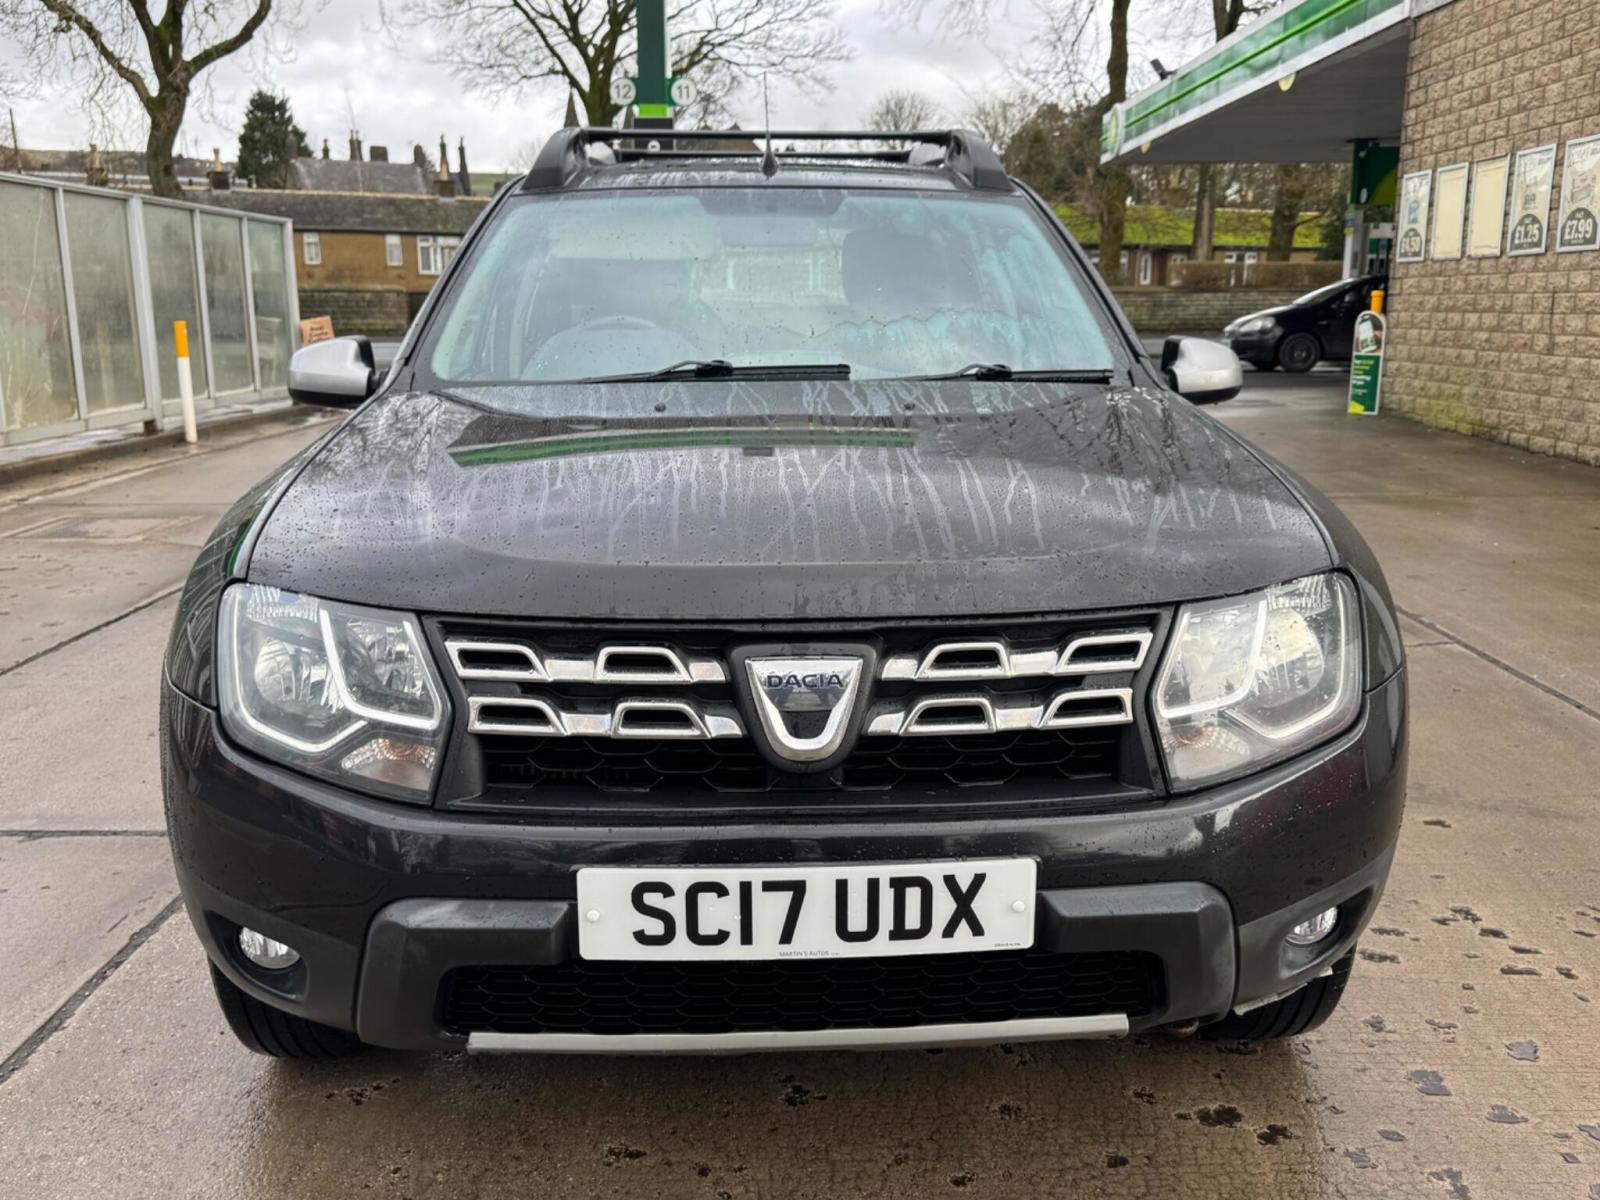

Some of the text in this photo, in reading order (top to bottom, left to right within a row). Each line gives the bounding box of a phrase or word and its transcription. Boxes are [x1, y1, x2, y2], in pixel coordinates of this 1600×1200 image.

[614, 84, 632, 100] 12
[676, 84, 691, 100] 11
[1514, 223, 1540, 244] £1.25
[1564, 217, 1593, 240] £7.99
[767, 674, 844, 688] DACIA
[630, 872, 987, 945] SC17 UDX
